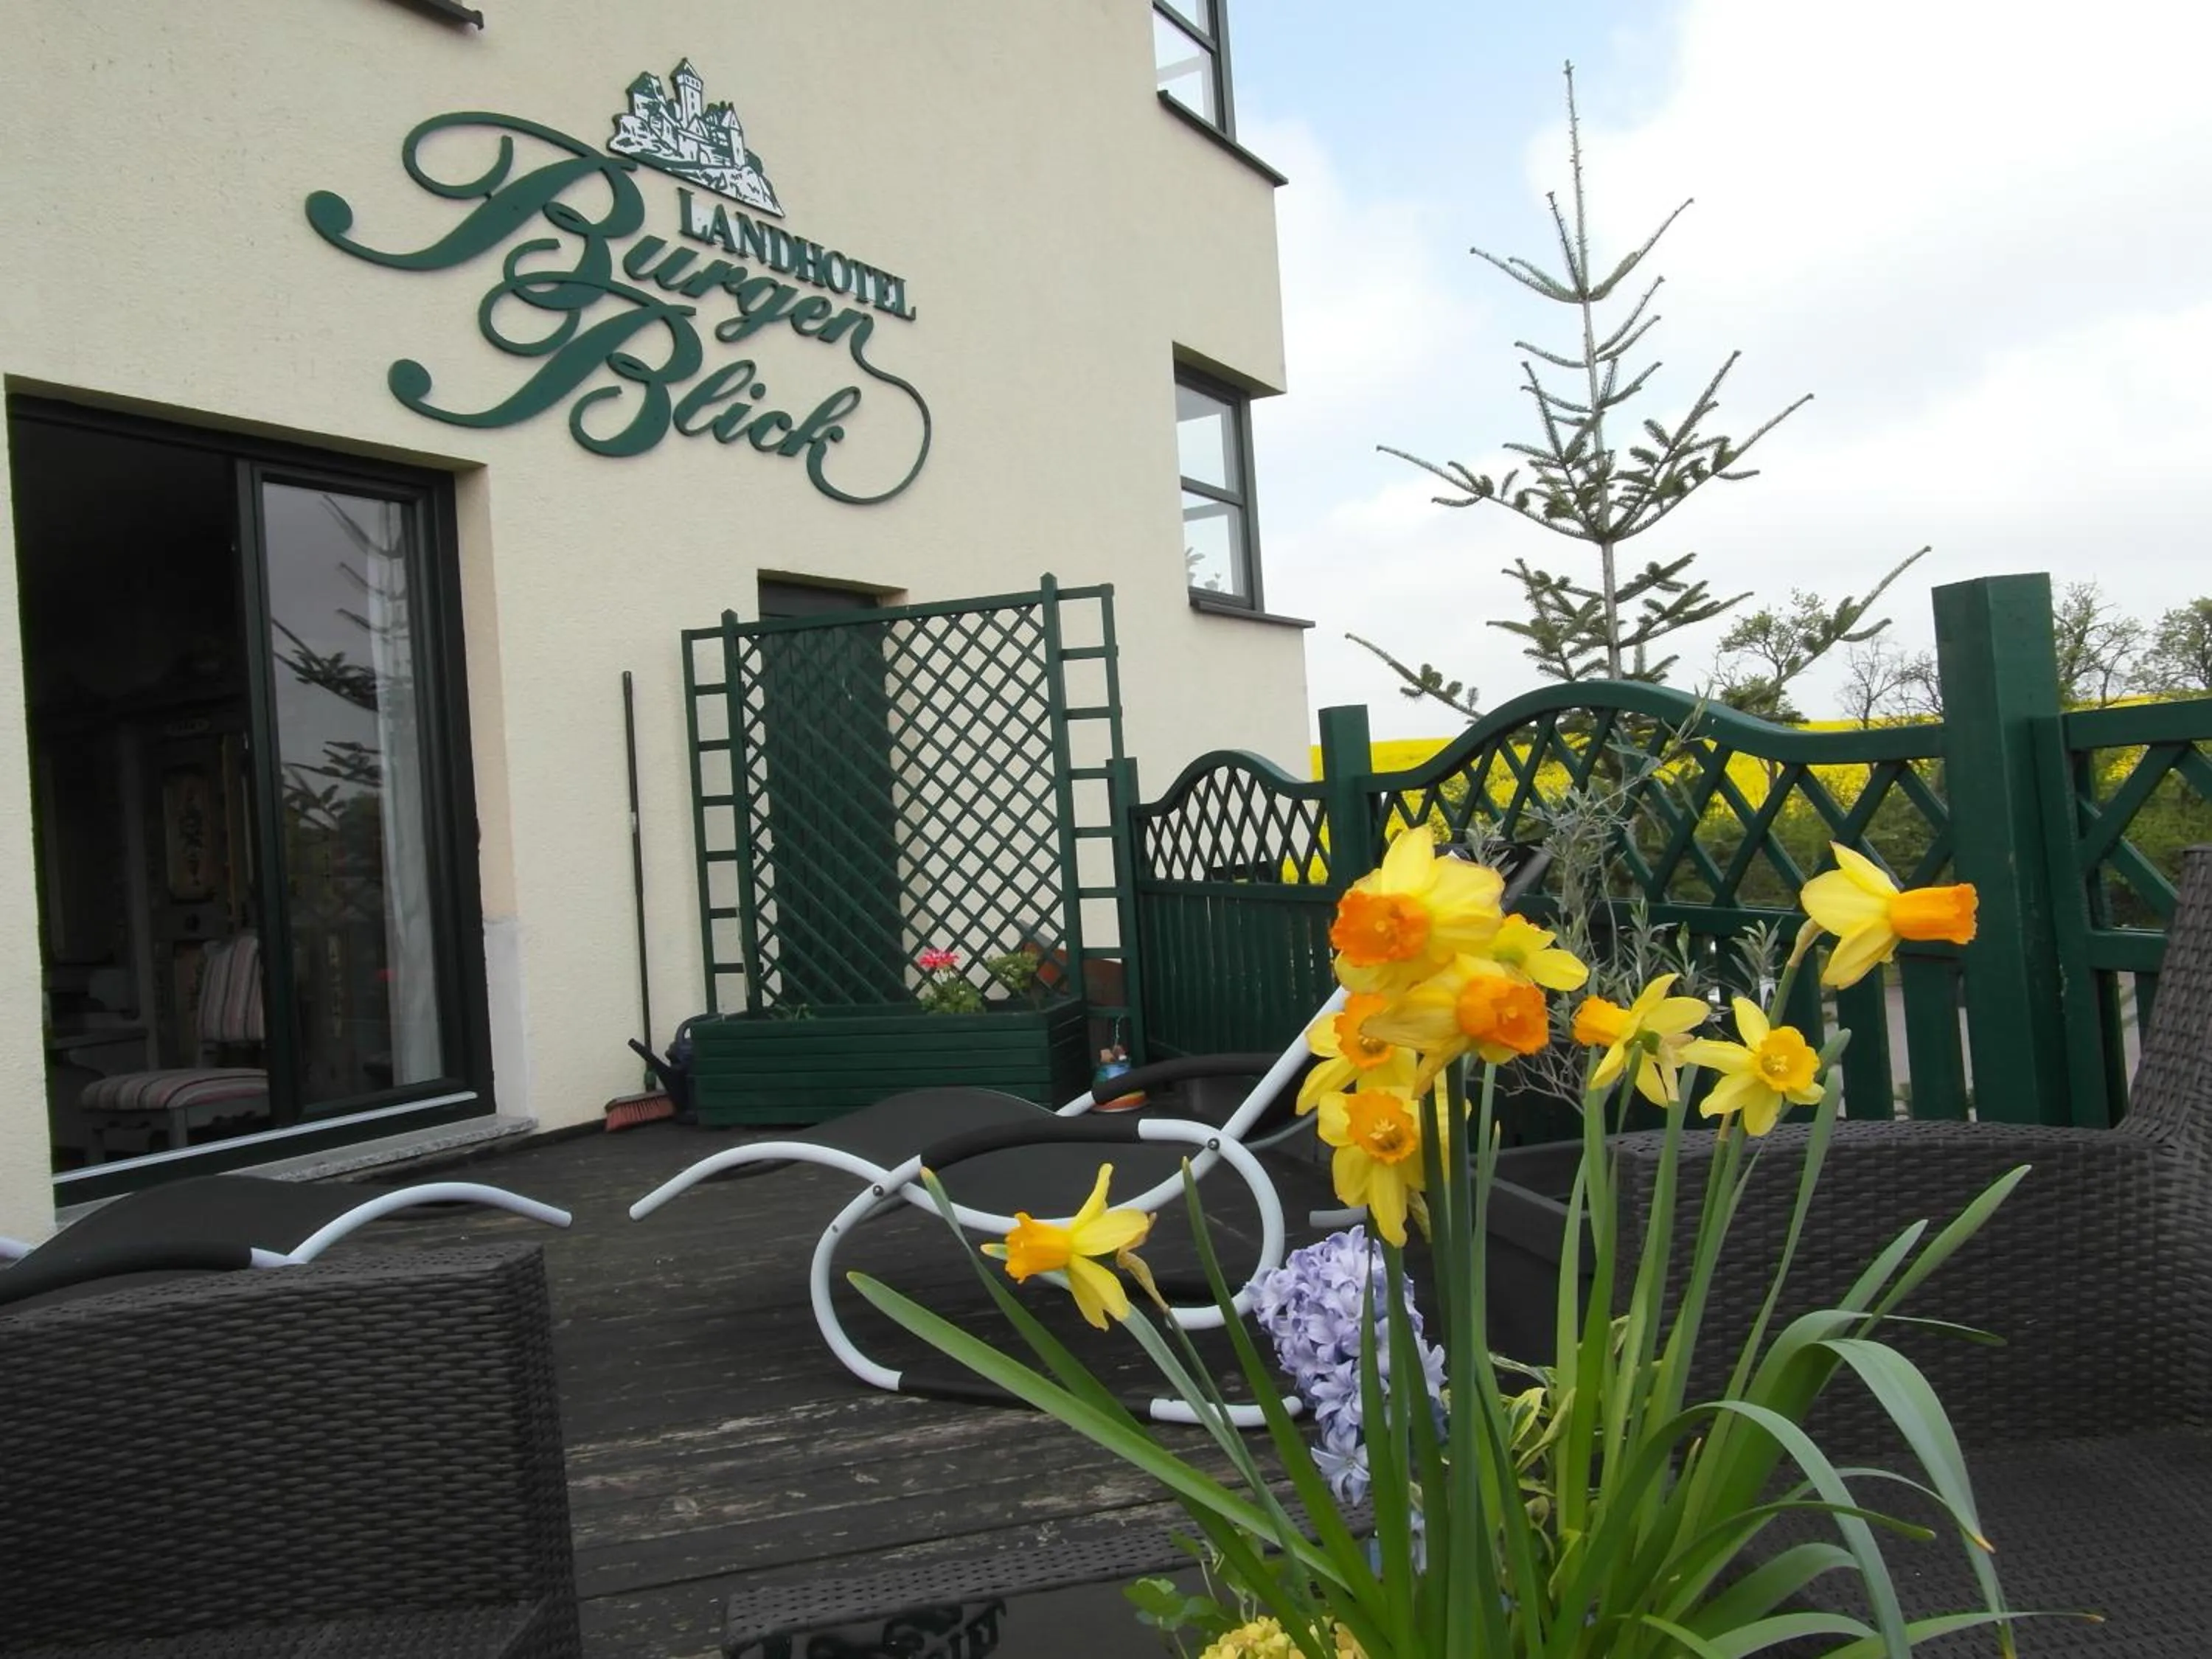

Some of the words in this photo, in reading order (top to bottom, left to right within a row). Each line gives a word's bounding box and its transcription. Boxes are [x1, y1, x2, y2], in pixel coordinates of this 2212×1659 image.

[305, 111, 877, 345] Burgen
[678, 187, 916, 321] LANDHOTEL
[388, 270, 863, 472] Blick
